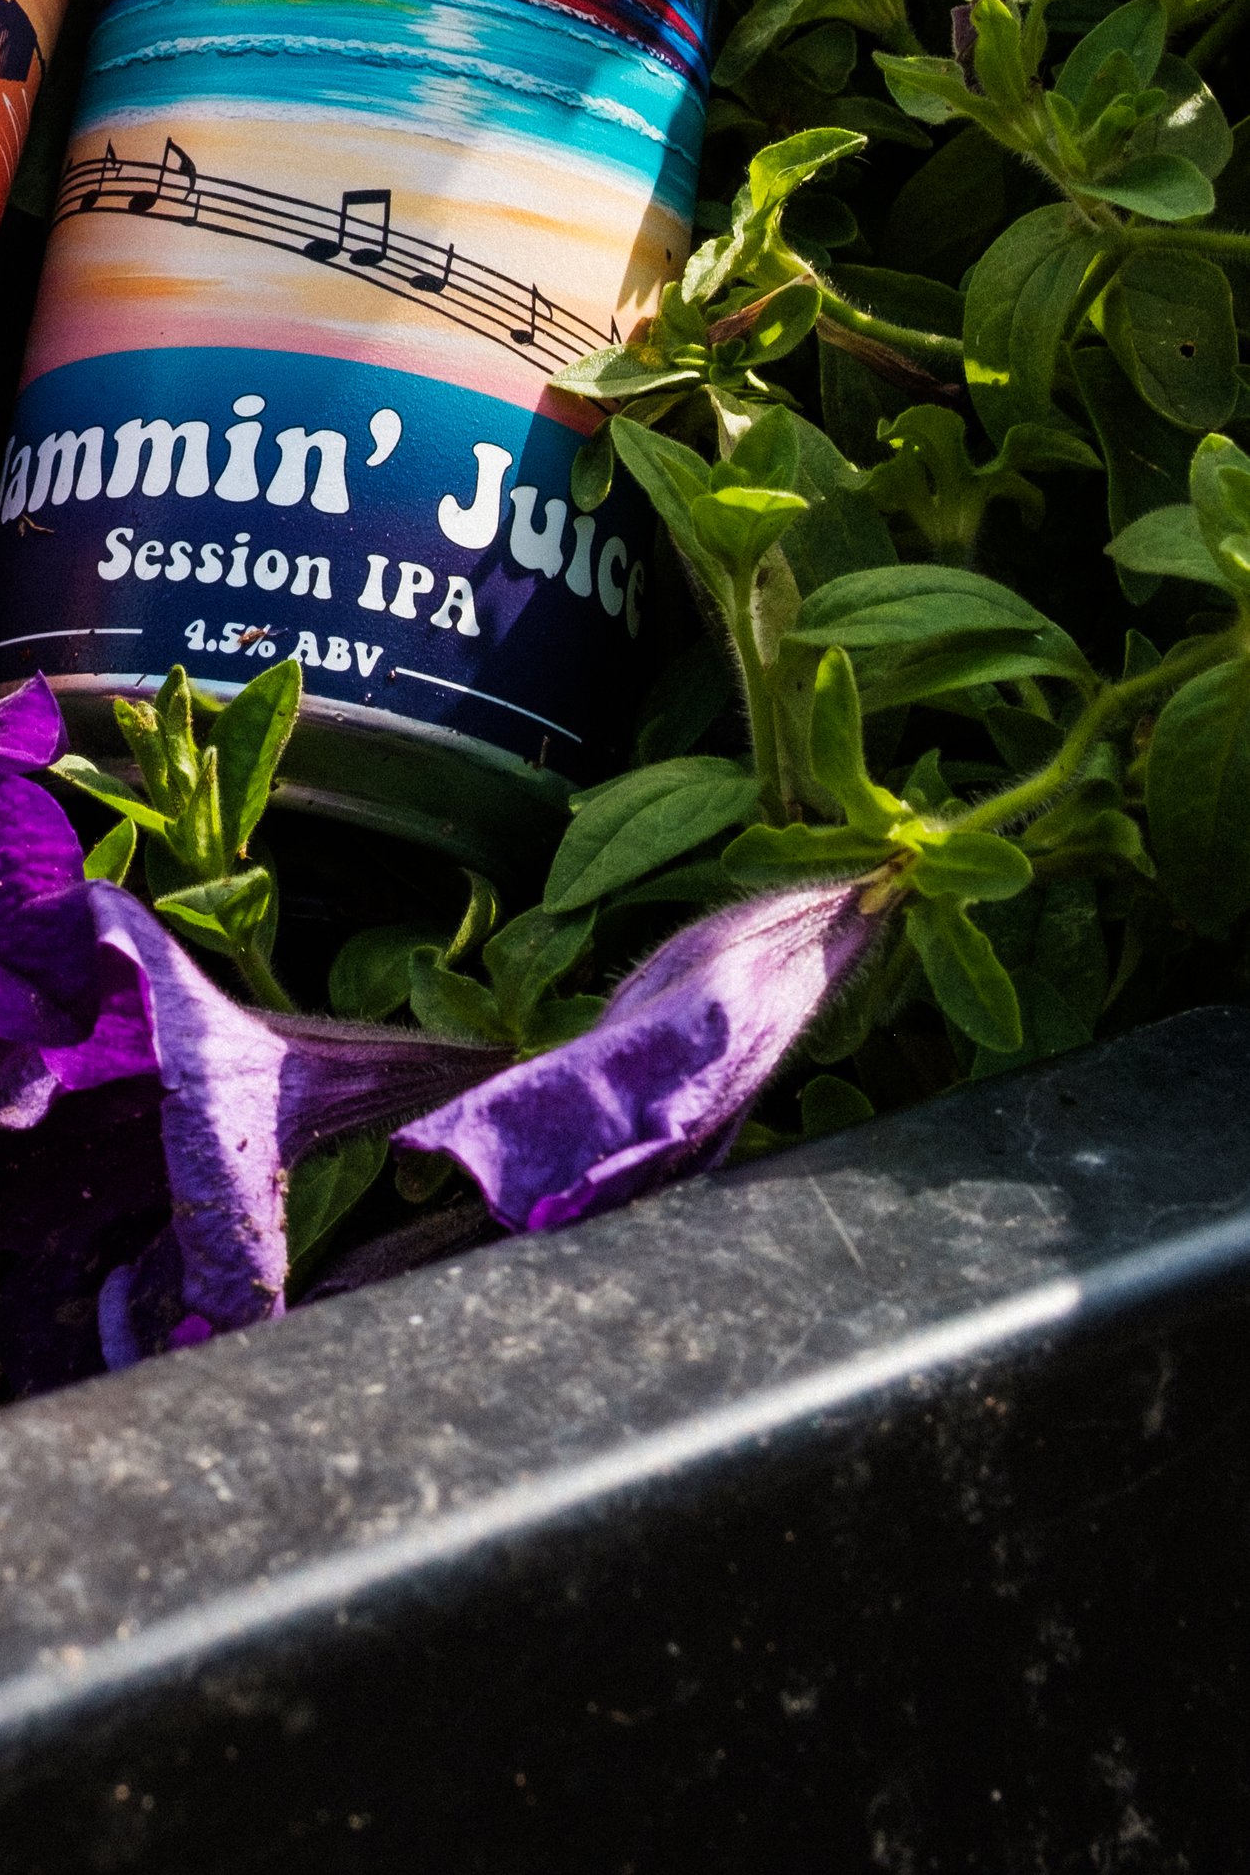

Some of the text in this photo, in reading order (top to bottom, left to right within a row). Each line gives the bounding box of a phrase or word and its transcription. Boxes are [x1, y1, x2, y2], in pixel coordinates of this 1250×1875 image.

[97, 527, 481, 637] Session IPA
[184, 619, 384, 678] 4.5% ABV
